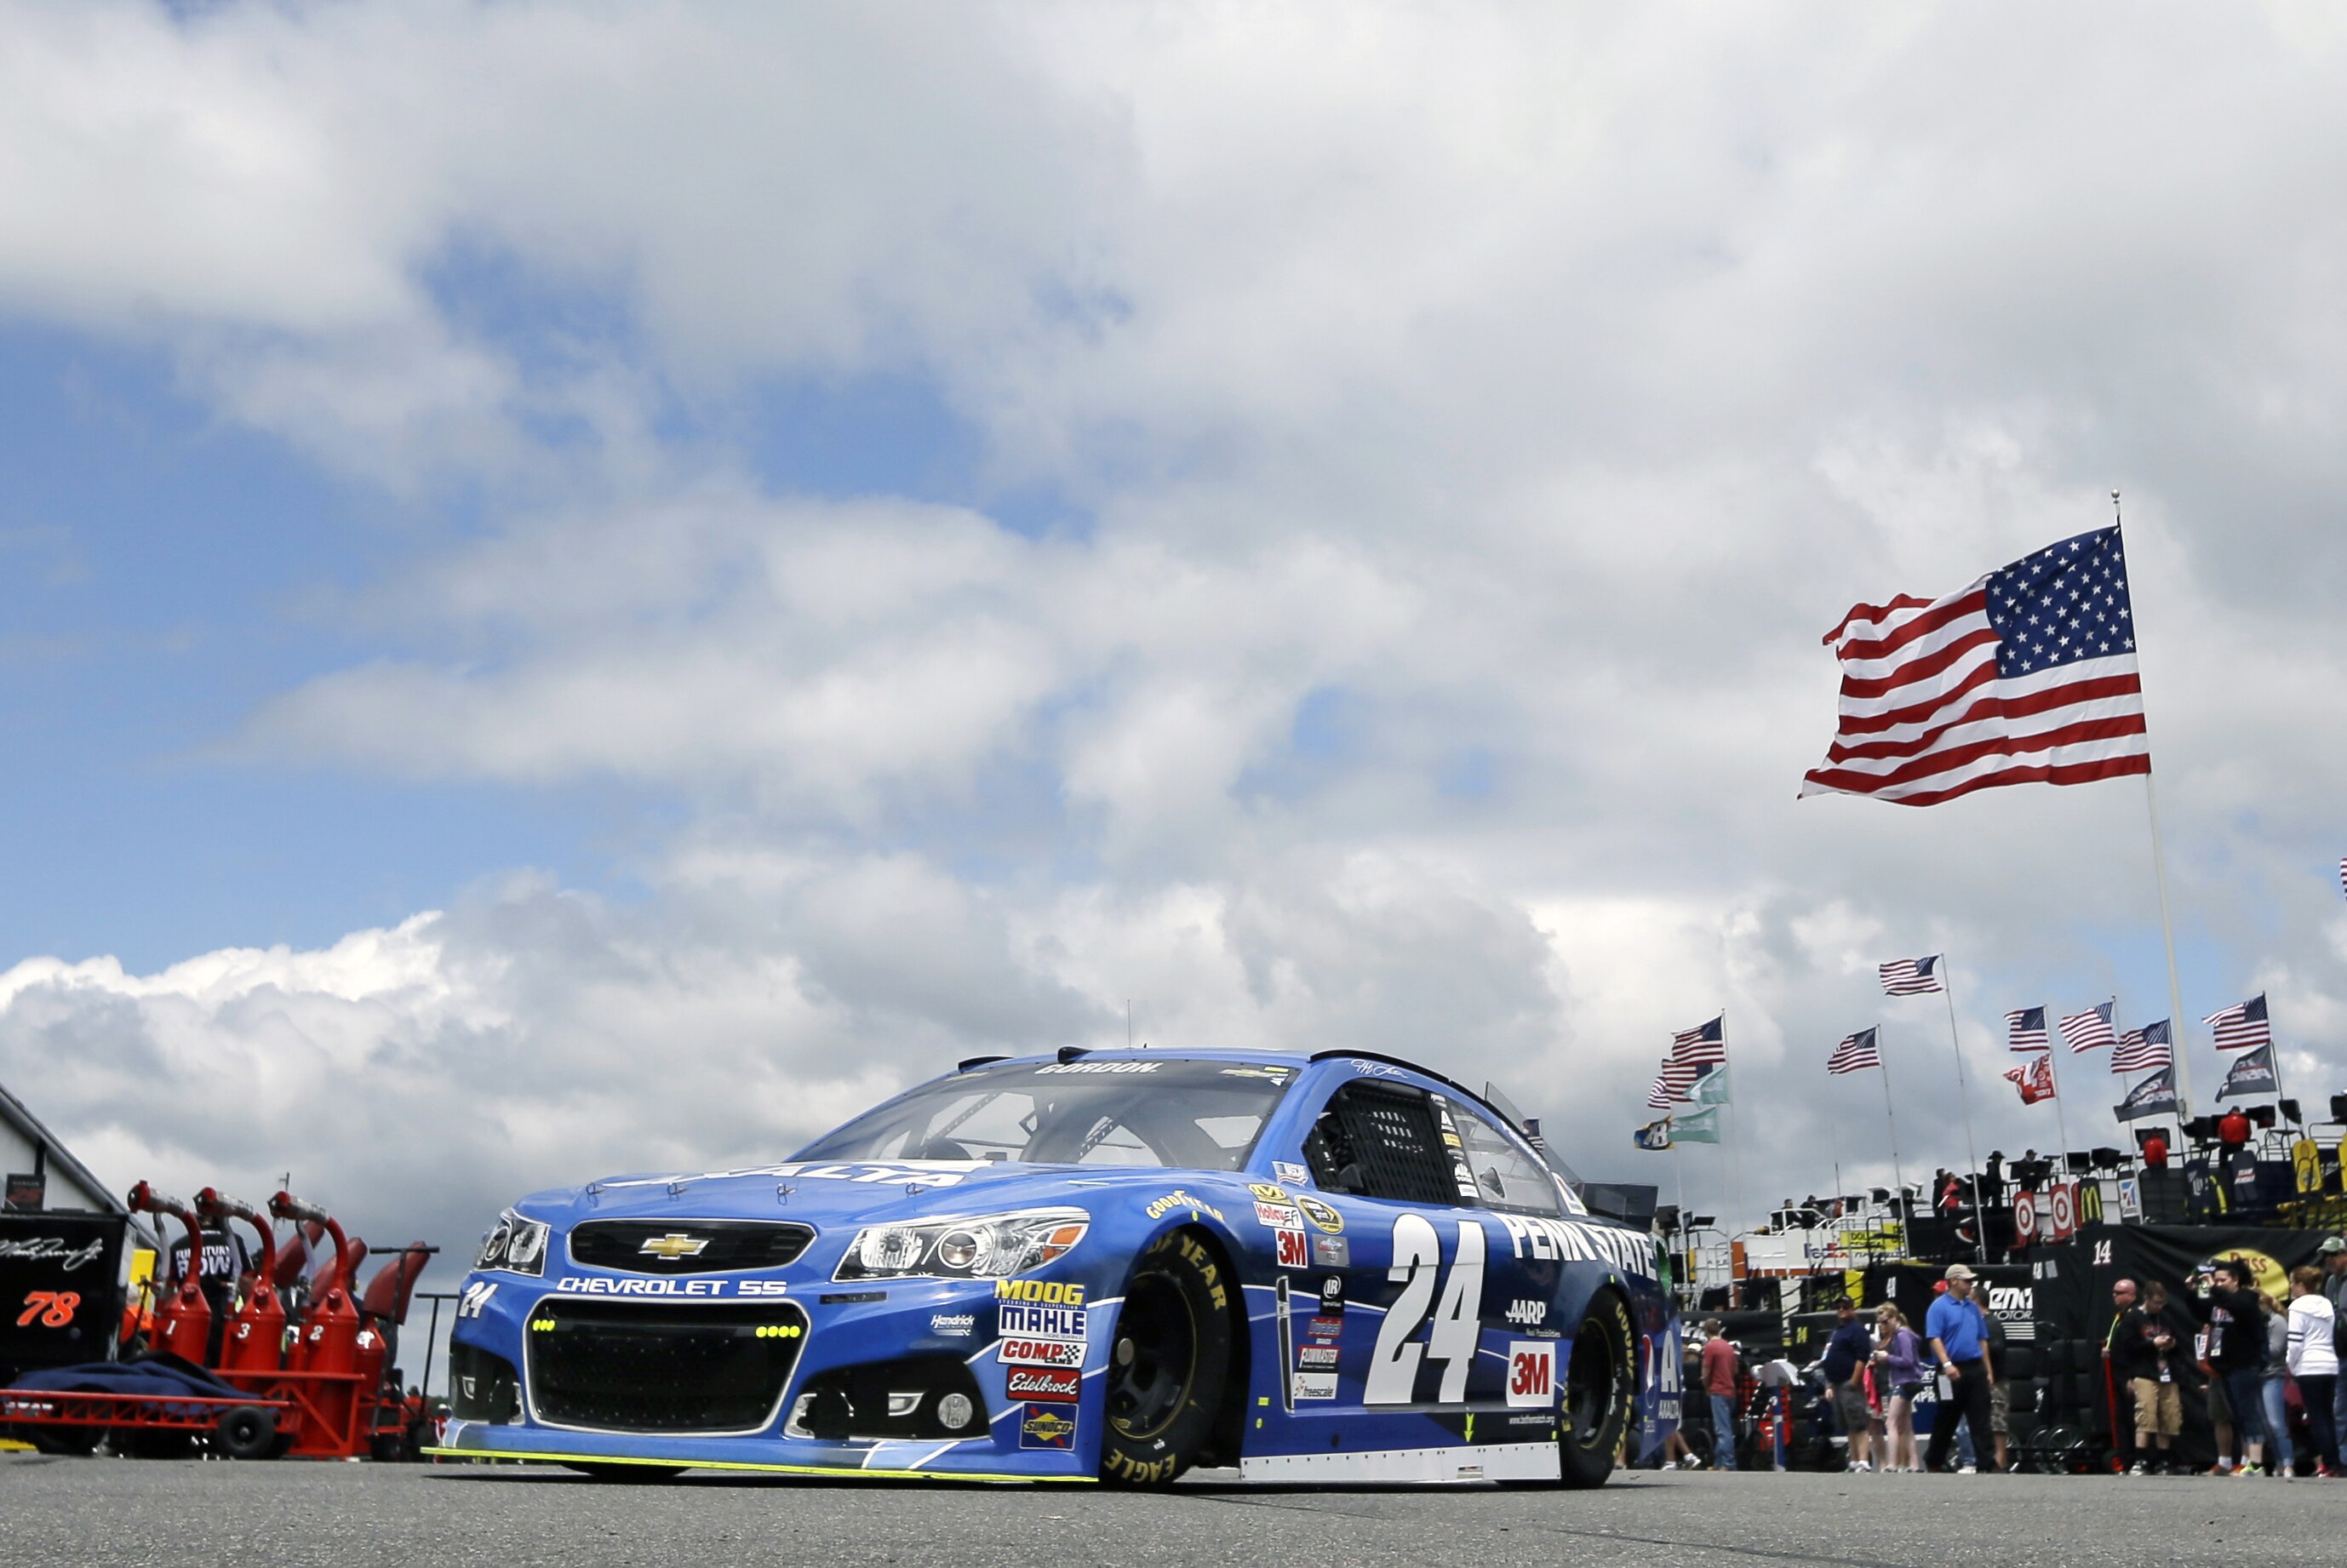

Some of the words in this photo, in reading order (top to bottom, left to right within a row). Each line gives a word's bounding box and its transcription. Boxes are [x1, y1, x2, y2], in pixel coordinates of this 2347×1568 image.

[1278, 1230, 1307, 1267] 3M
[1491, 1212, 1597, 1262] PENN
[1577, 1222, 1658, 1281] STATE
[2092, 1239, 2111, 1266] 14
[459, 1281, 498, 1319] 24
[556, 1277, 728, 1296] CHEVROLET
[737, 1280, 787, 1296] SS
[994, 1279, 1085, 1306] MOOG
[16, 1290, 81, 1328] 78
[930, 1314, 976, 1329] Hendrick
[1001, 1306, 1085, 1336] MAHLE
[1362, 1213, 1485, 1405] 24
[1505, 1300, 1546, 1325] AARP
[238, 1323, 250, 1338] 3
[310, 1325, 323, 1341] 2
[1003, 1340, 1064, 1360] COMP
[1008, 1371, 1078, 1395] Edelbrock
[1512, 1352, 1549, 1395] 3M
[1024, 1420, 1071, 1434] SUNOCO
[1104, 1449, 1177, 1483] EAGLE
